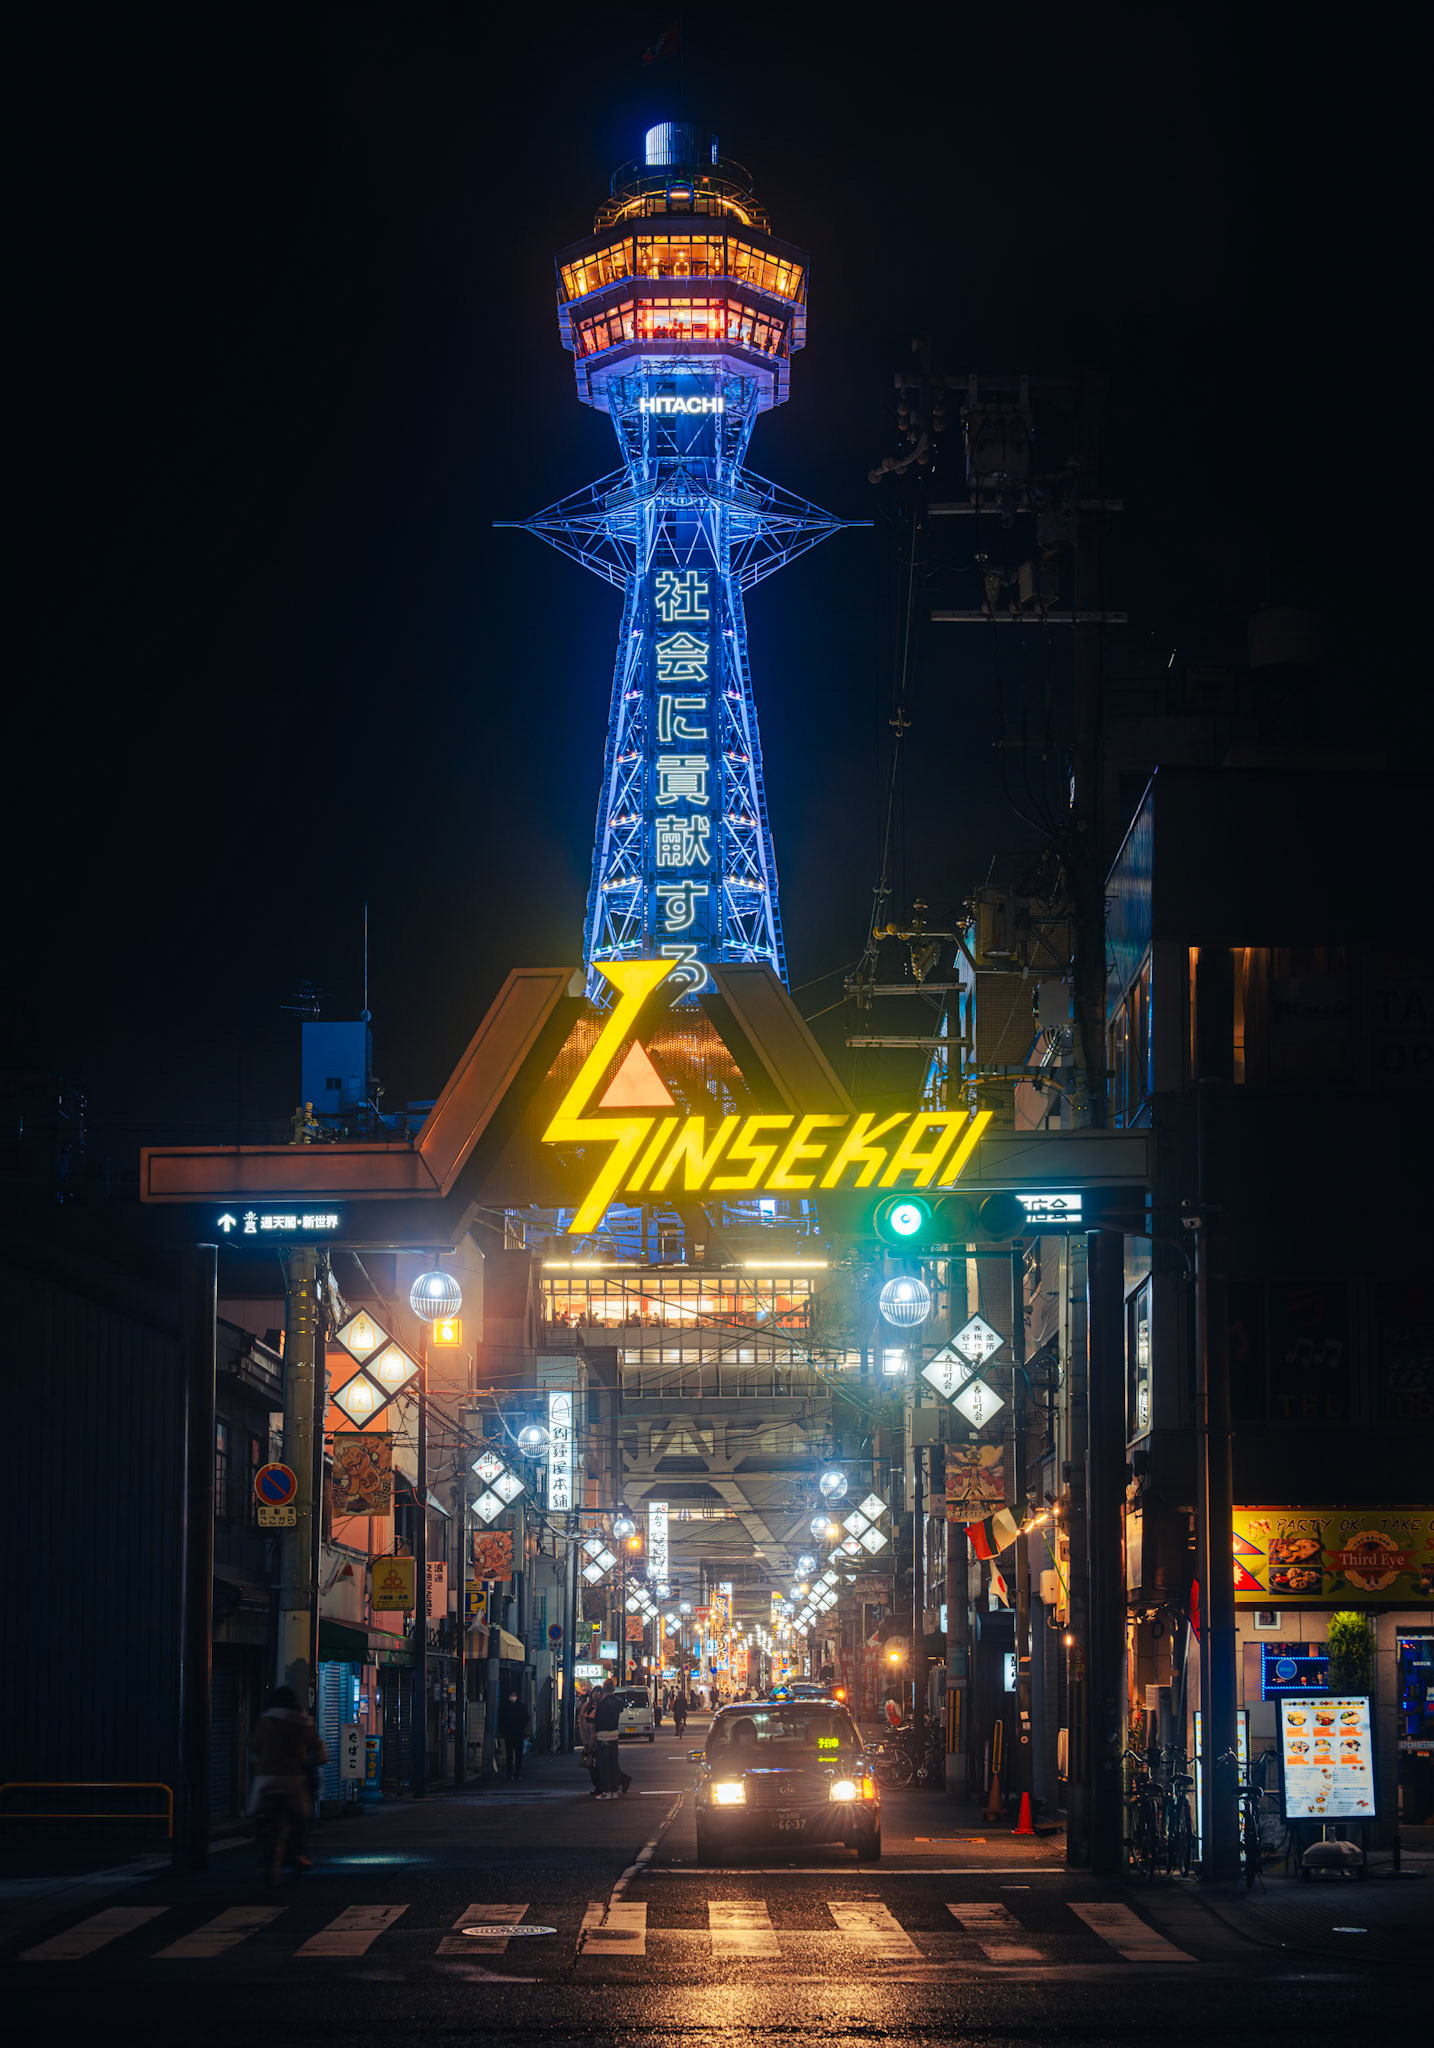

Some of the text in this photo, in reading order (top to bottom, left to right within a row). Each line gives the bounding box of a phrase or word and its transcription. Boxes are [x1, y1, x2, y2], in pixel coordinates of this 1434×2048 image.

[639, 397, 724, 413] HITACHI
[654, 569, 712, 1006] 社会に貢献する
[973, 1386, 984, 1421] 春日町会
[1276, 1518, 1334, 1532] PARTY
[1339, 1517, 1366, 1531] OK!
[1381, 1518, 1424, 1531] TAKE
[1339, 1552, 1406, 1569] Third Eye
[348, 1732, 360, 1768] たばこ
